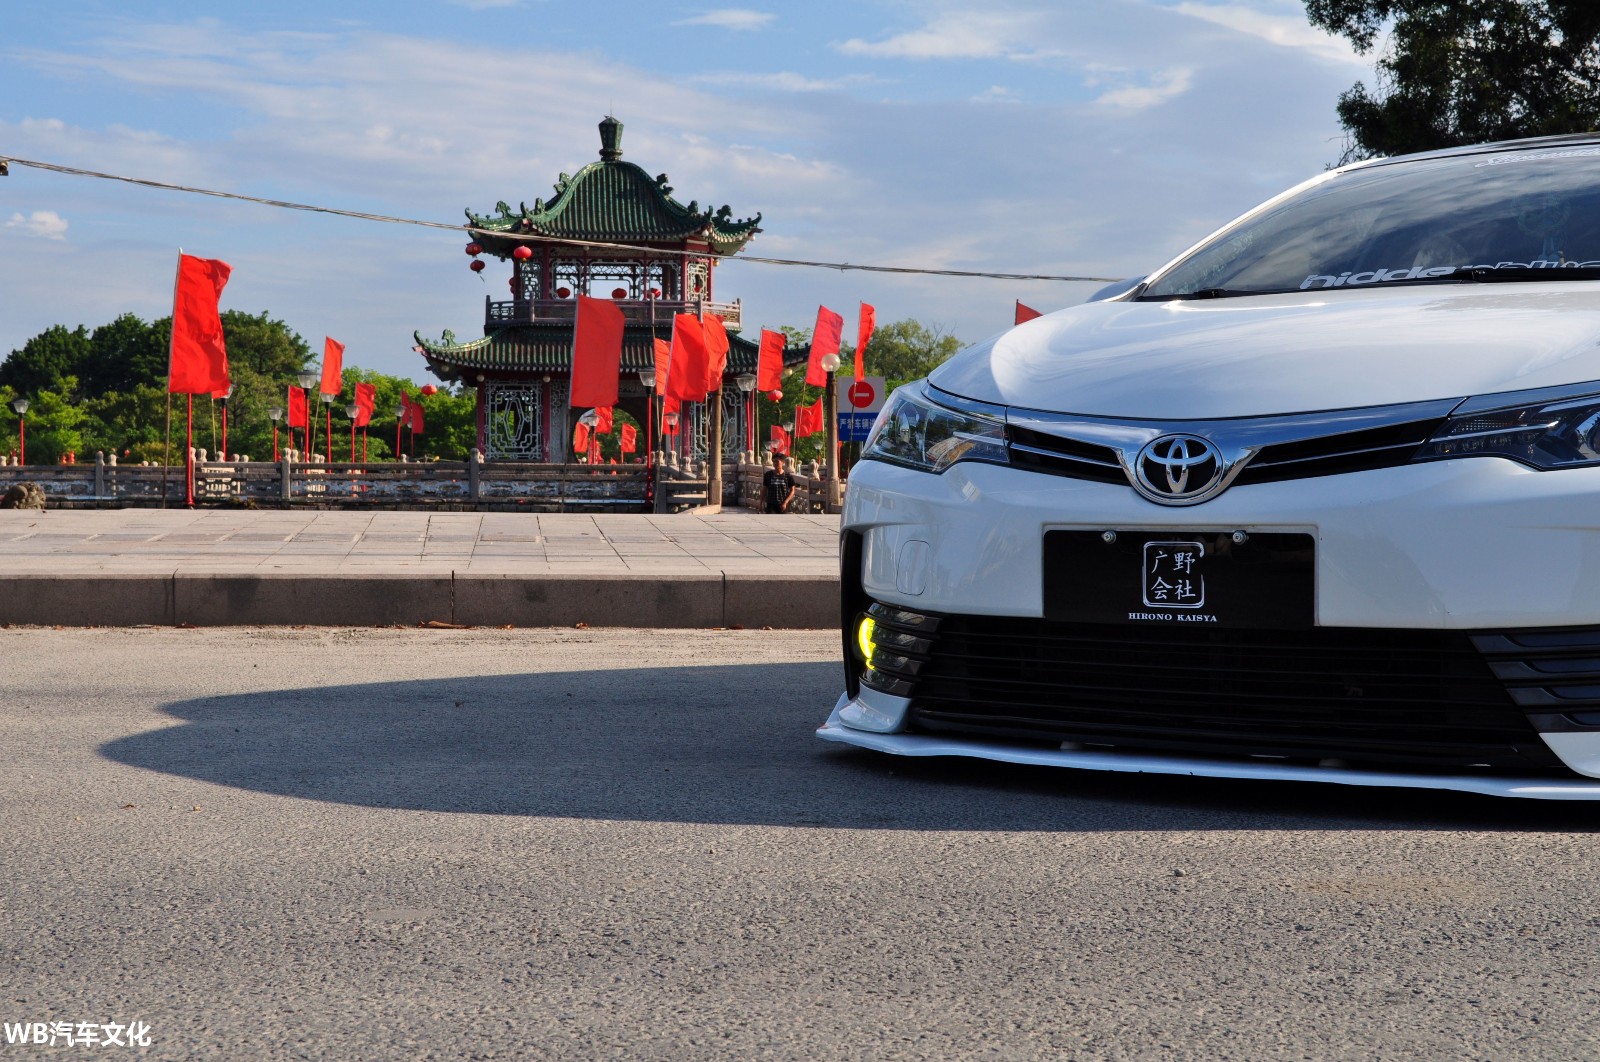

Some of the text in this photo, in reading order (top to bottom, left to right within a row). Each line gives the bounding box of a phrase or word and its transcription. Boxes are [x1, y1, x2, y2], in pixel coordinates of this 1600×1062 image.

[1300, 265, 1494, 289] hidde
[1151, 550, 1196, 574] 广野
[1151, 576, 1196, 600] 会社
[1128, 612, 1218, 622] HIRONO KAISYA
